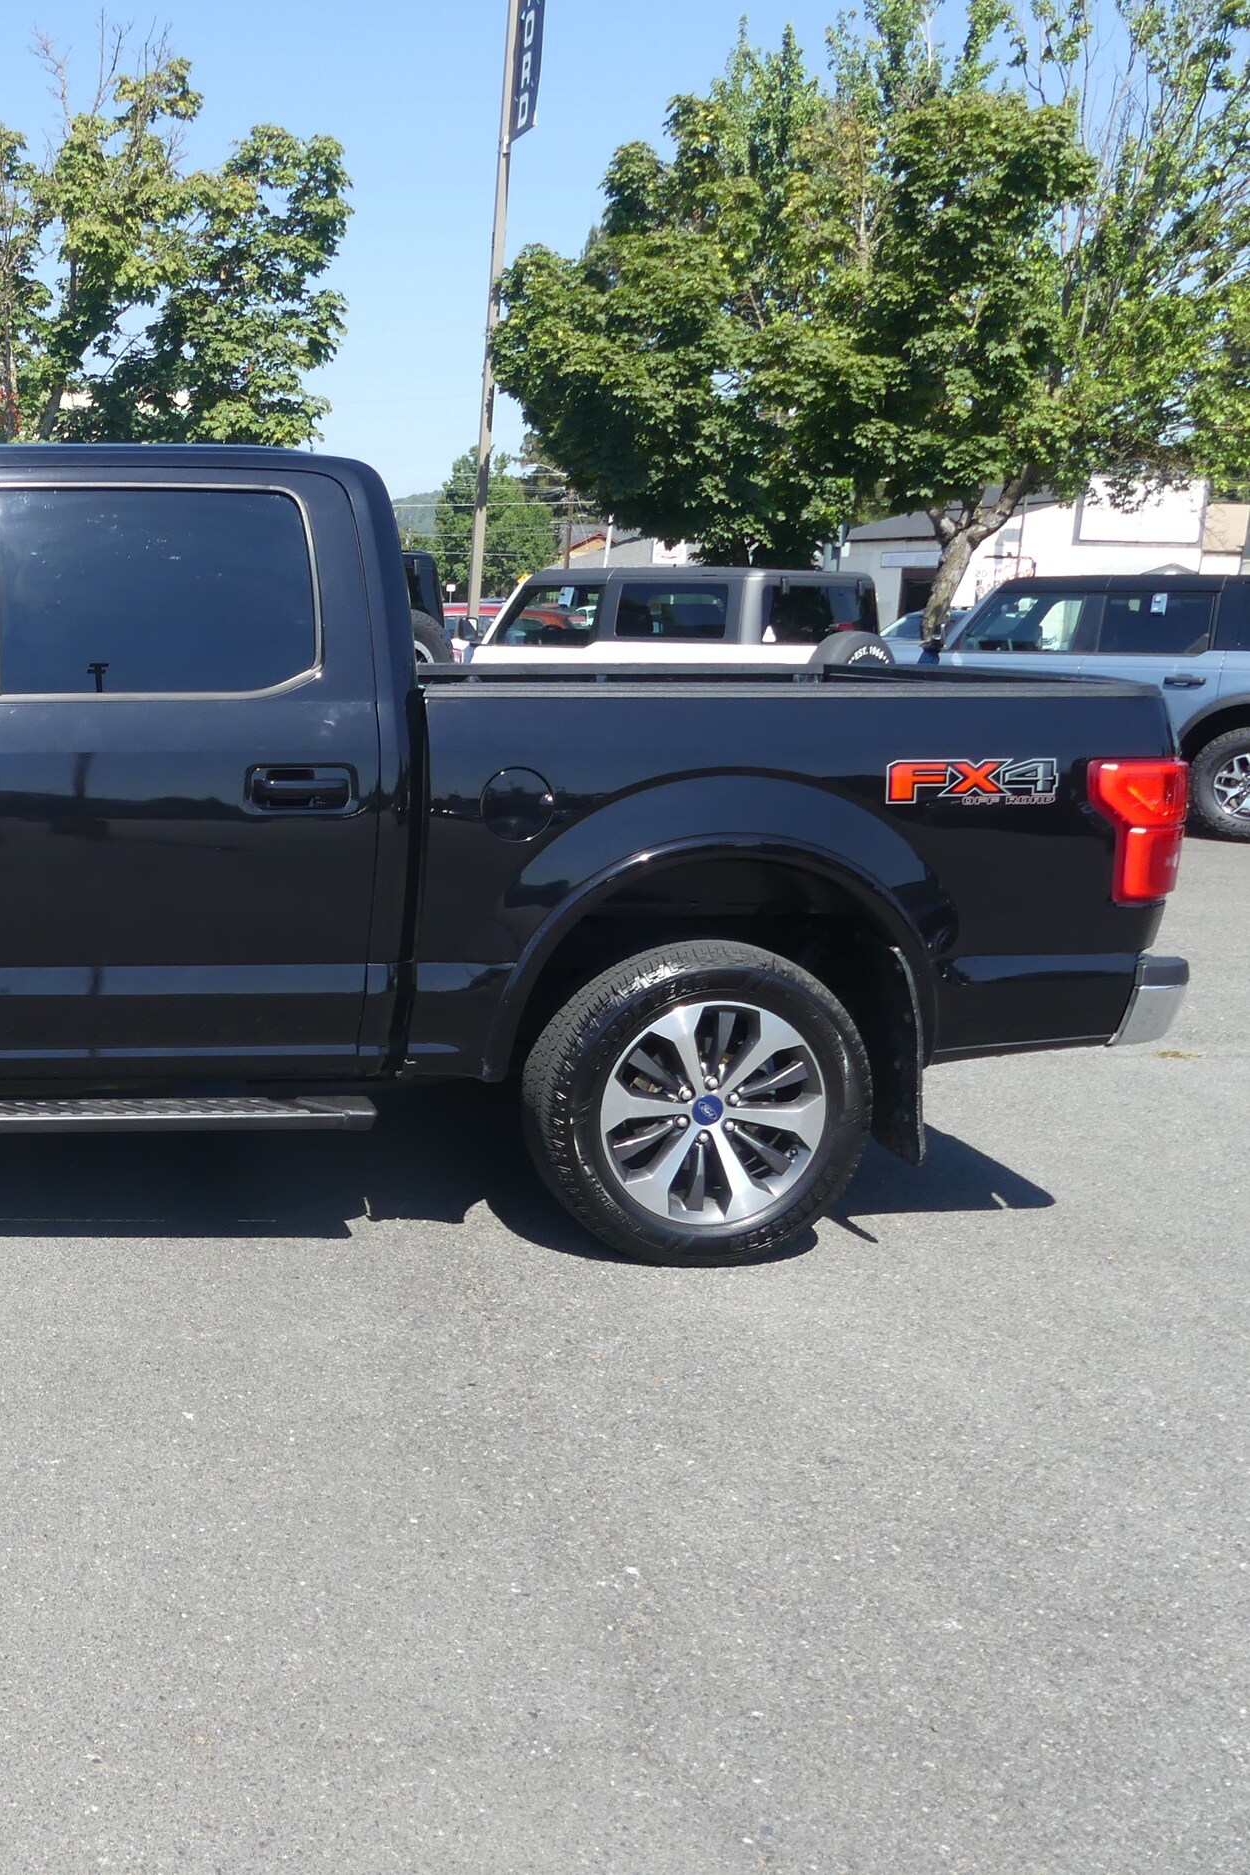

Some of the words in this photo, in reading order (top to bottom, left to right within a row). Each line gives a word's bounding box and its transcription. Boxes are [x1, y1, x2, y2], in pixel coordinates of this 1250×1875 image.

[885, 758, 1059, 804] FX4
[961, 795, 1001, 806] OFF
[1005, 795, 1056, 805] ROAD
